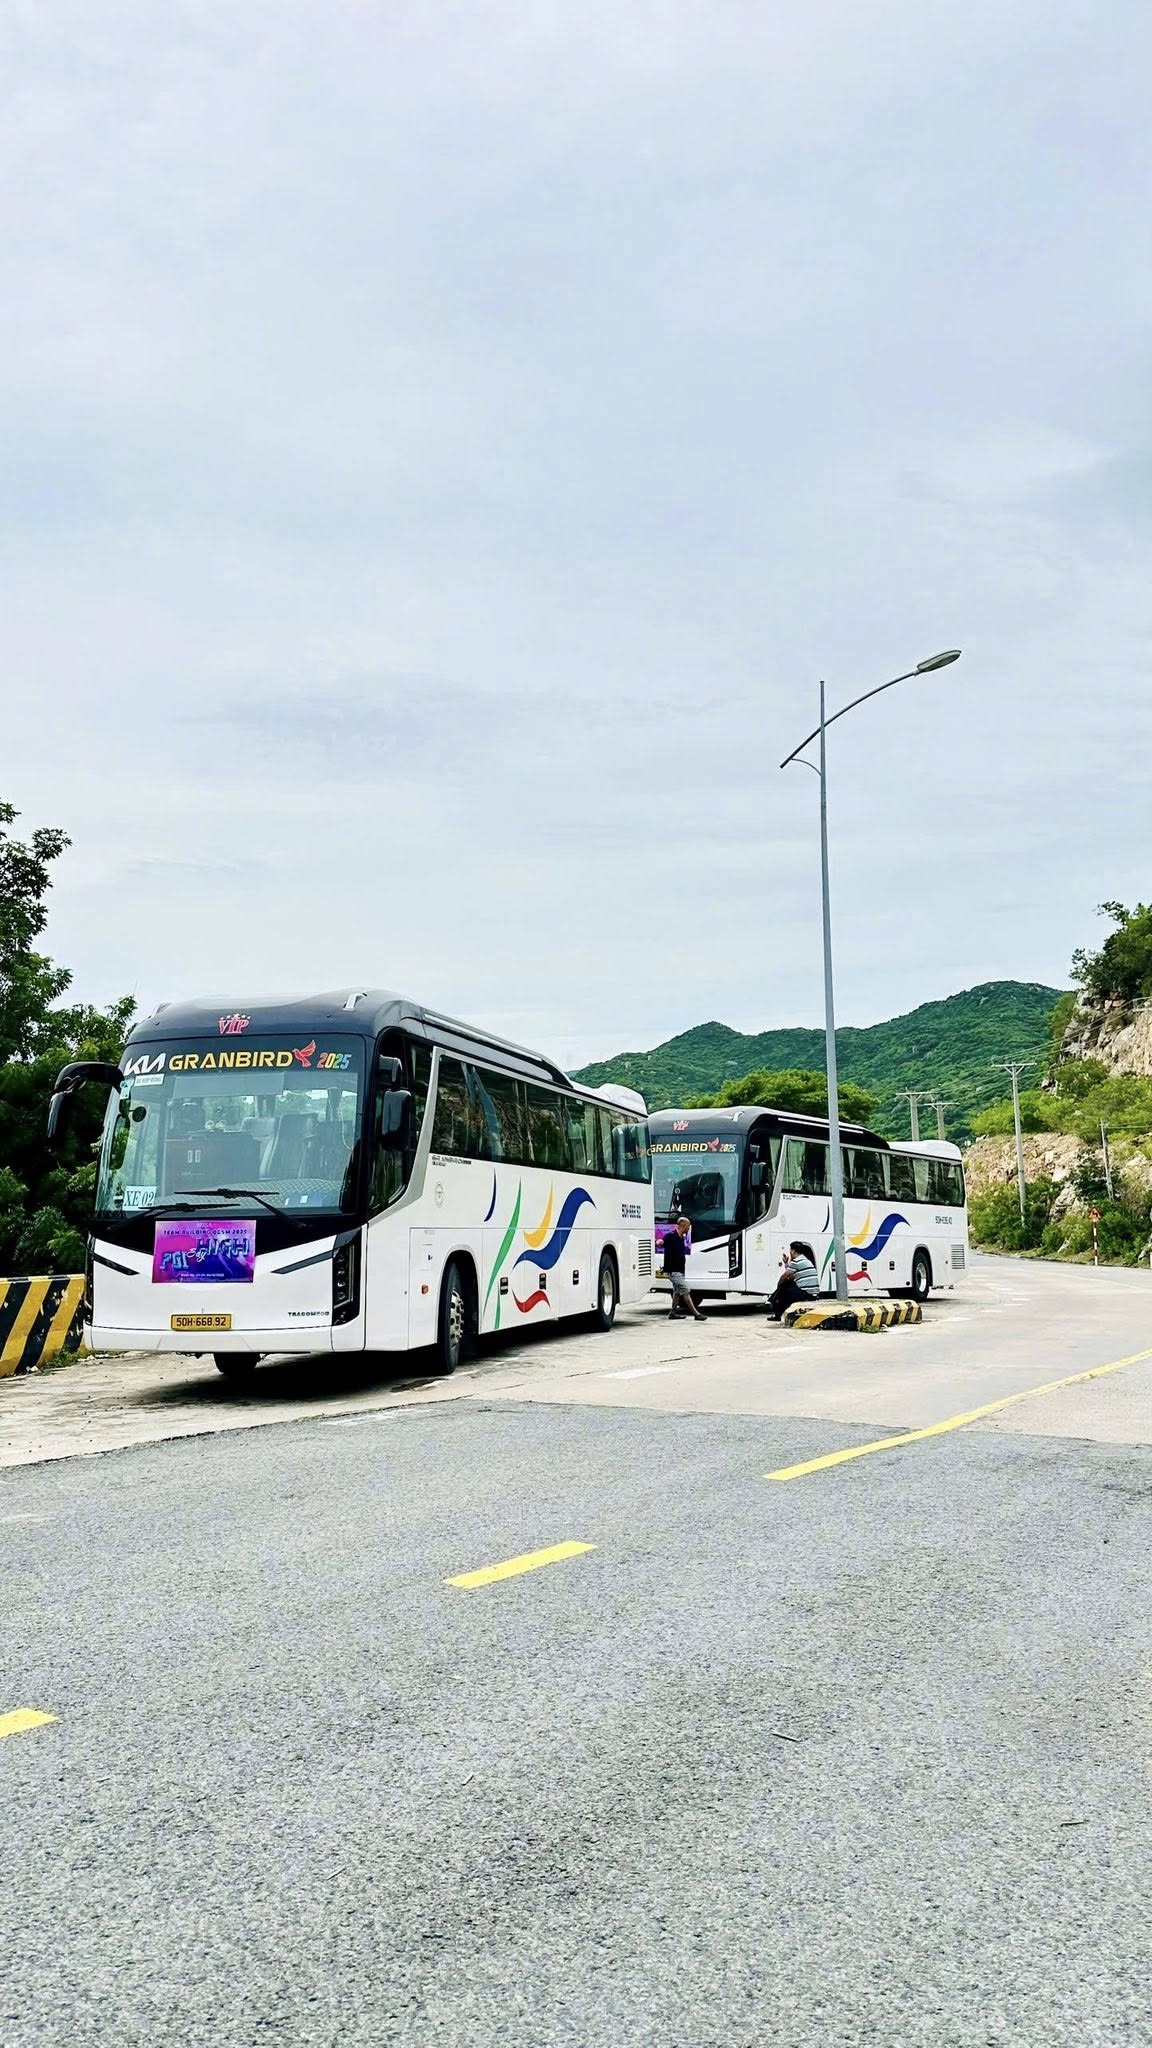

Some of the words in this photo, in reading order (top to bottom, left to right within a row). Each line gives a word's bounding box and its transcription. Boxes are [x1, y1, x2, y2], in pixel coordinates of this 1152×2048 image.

[218, 1016, 250, 1034] VIP
[168, 1051, 294, 1071] GRANBIRD
[316, 1052, 352, 1070] 2025
[719, 1143, 736, 1153] 2025
[124, 1190, 141, 1206] XE
[142, 1191, 154, 1206] 02
[186, 1248, 208, 1263] Say
[176, 1316, 226, 1328] 50H-668.92
